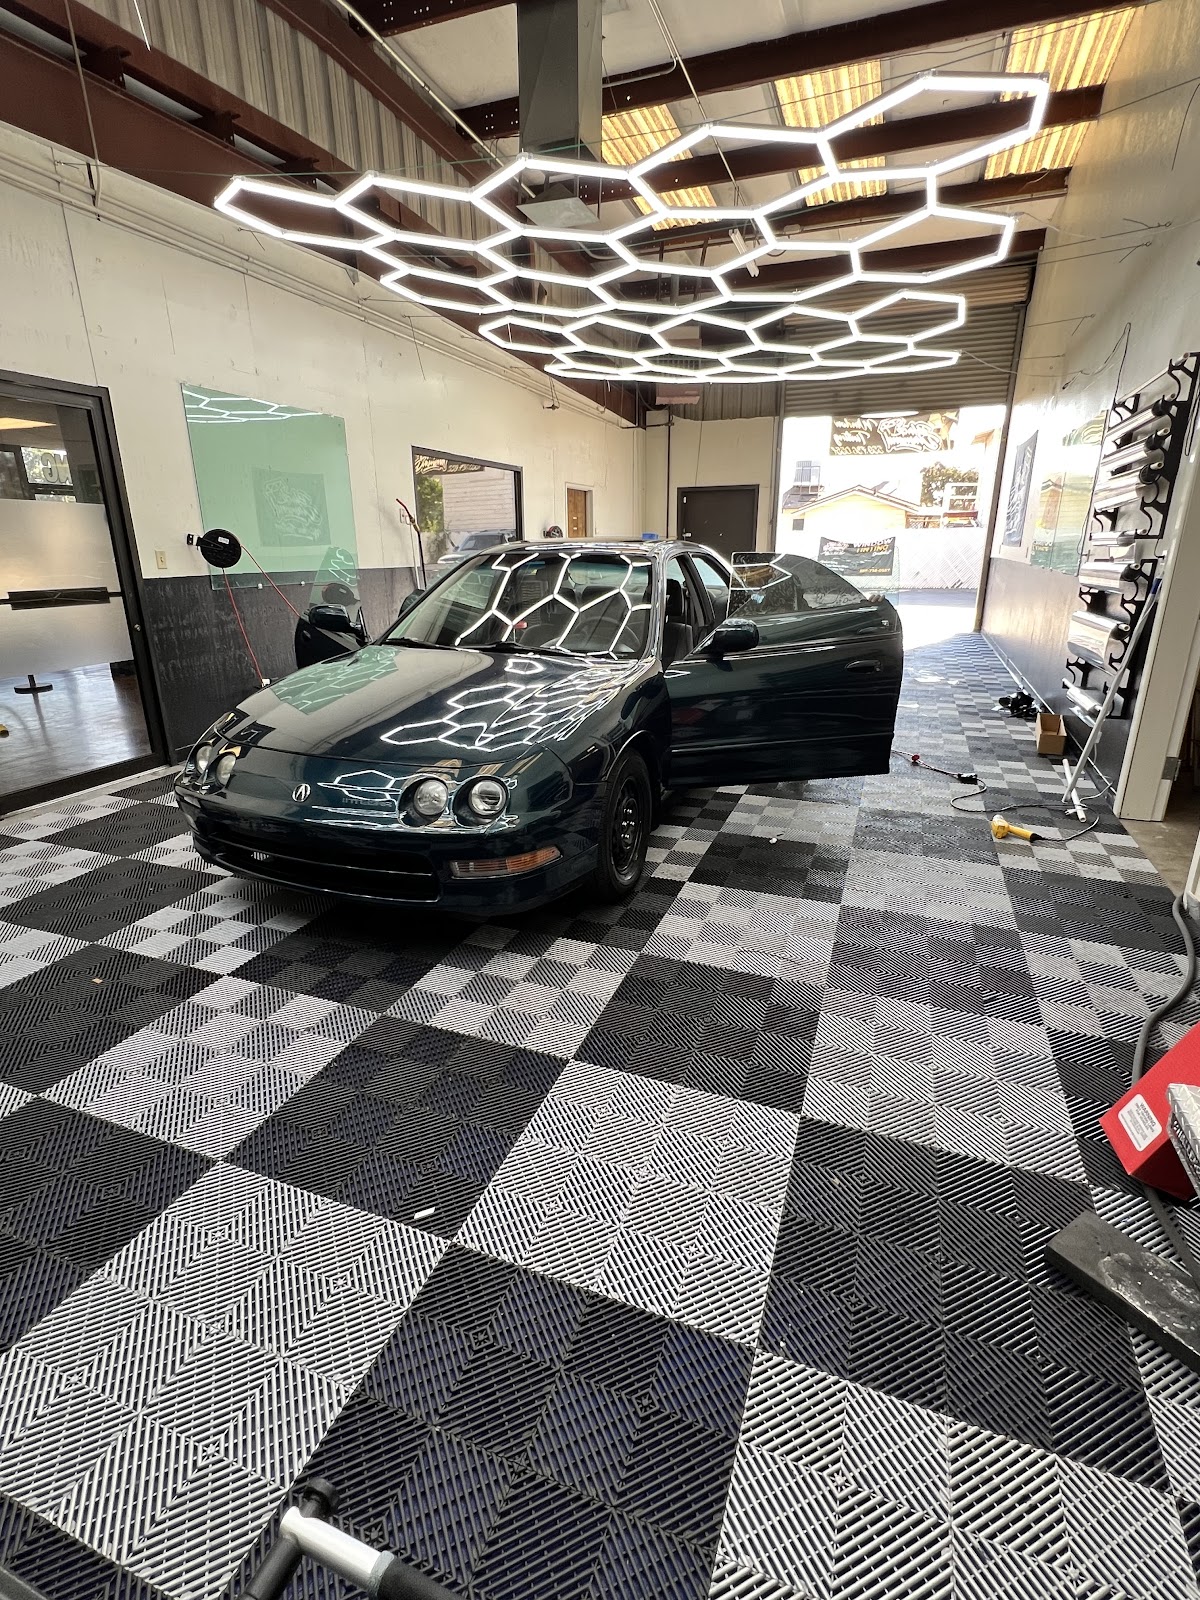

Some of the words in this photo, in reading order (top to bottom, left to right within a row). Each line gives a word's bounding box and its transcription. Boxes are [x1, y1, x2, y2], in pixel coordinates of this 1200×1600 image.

[853, 538, 893, 547] WINDOW
[856, 544, 889, 553] TINTING
[1140, 1102, 1156, 1127] WARNING
